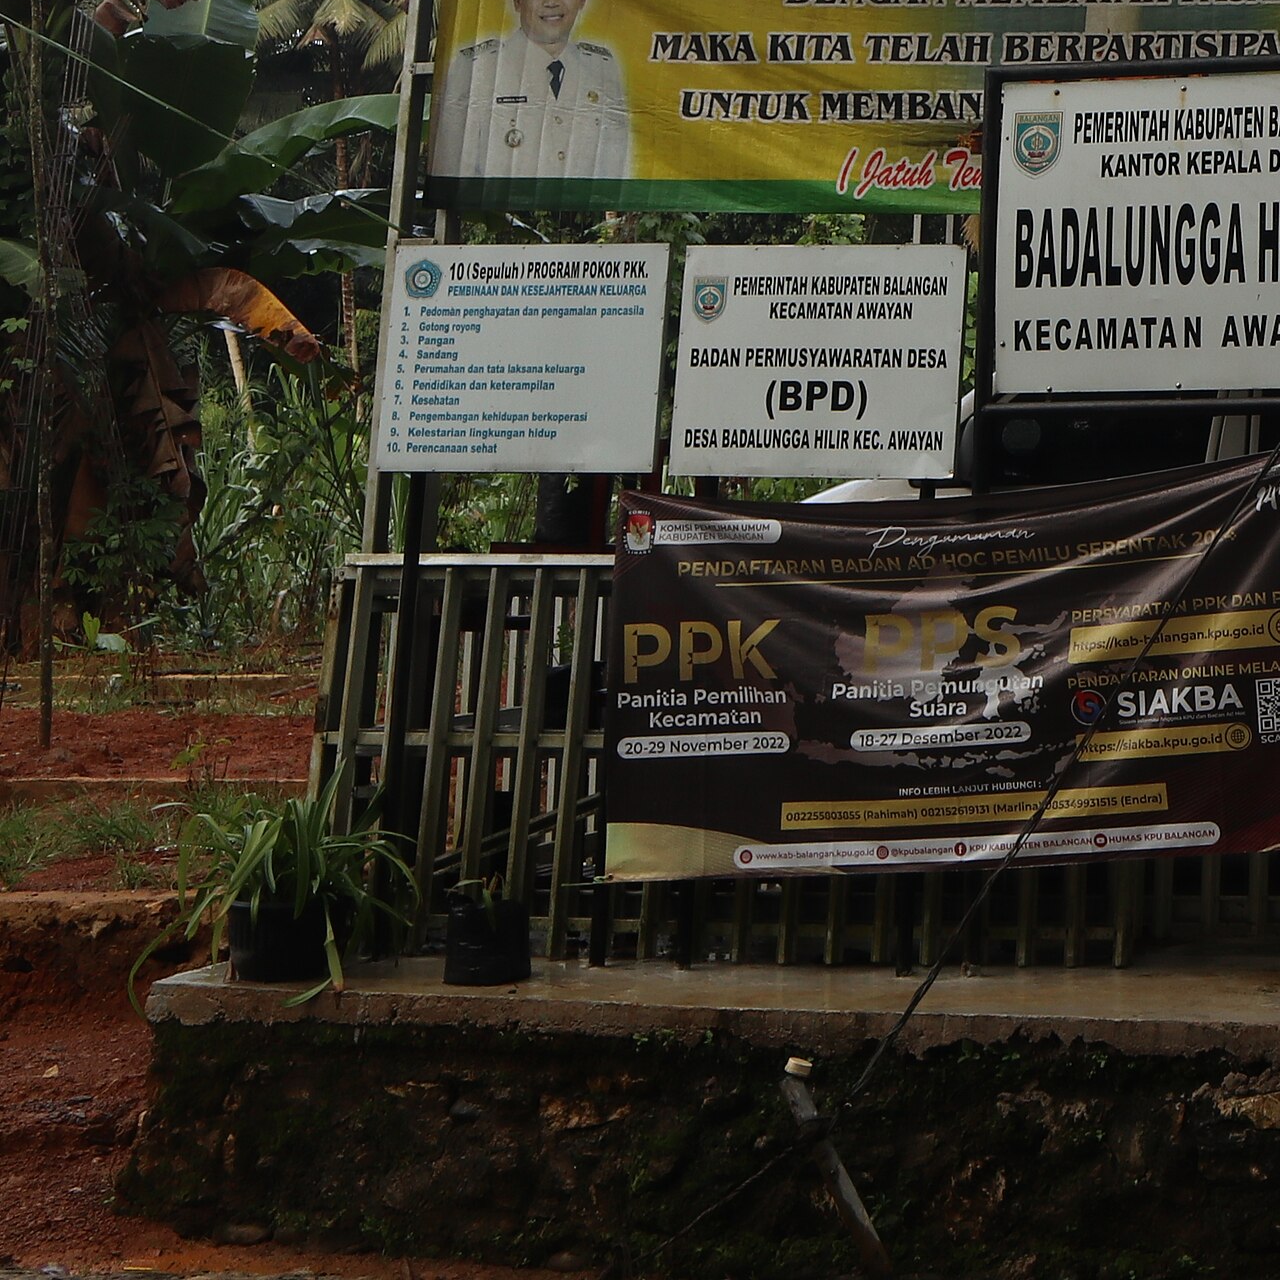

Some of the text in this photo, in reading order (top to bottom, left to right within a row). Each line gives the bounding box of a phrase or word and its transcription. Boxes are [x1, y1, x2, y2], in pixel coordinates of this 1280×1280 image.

[650, 34, 759, 62] MAKA
[768, 33, 852, 63] KITA
[866, 32, 991, 63] TELAH
[681, 90, 808, 121] UNTUK
[1073, 109, 1170, 144] PEMERINTAH
[1174, 106, 1264, 141] KABUPATEN
[1101, 153, 1180, 178] KANTOR
[1186, 150, 1262, 175] KEPALA
[1014, 202, 1246, 288] BADALUNGGA
[527, 261, 580, 279] PROGRAM
[582, 261, 620, 279] POKOK
[623, 261, 649, 279] PKK.
[448, 285, 647, 297] PEMBINAAN DAN KESEJAHTERAAN KELUARGA
[733, 276, 947, 296] PEMERINTAH KABUPATEN BALANGAN
[420, 305, 645, 319] Pedoman penghayatan pengamalan pancasila
[769, 302, 913, 320] KECAMATAN AWAYAN
[401, 322, 409, 332] 2.
[1014, 316, 1201, 352] KECAMATAN
[418, 336, 455, 347] Pangan
[416, 350, 458, 361] Sandang
[690, 348, 947, 369] BADAN PERMUSYAWARATAN DESA
[414, 364, 465, 374] Perumahan
[413, 380, 555, 392] Pendidikan keterampilan
[411, 395, 460, 405] Kesehatan
[765, 380, 868, 420] (BPD)
[409, 411, 588, 423] Pengembangan berkoperasi
[408, 427, 525, 439] Kelestarian lingkungan
[684, 429, 943, 451] DESA BADALUNGGA HILIR KEC. AWAYAN
[406, 443, 468, 453] Perencanaan
[678, 532, 1187, 577] PENDAFTARAN BADAN AD HOC PEMILU SERENTAK
[1071, 600, 1187, 623] PERSYARATAN
[1192, 596, 1228, 610] PPK
[1232, 592, 1267, 607] DAN
[864, 605, 1021, 674] PPS
[623, 619, 781, 684] PPK
[1182, 663, 1235, 679] ONLINE
[832, 674, 1044, 700] Panitia Pemungutan
[617, 686, 787, 709] Panitia Pemilihan
[1117, 683, 1244, 719] SIAKBA
[649, 709, 762, 729] Kecamatan
[909, 700, 967, 718] Suara
[625, 736, 785, 755] 20-29 November 2022
[859, 726, 1022, 747] 18-27 Desember 2022
[899, 784, 989, 797] INFO LANJUT
[863, 808, 918, 822] (Rahimah)
[1120, 793, 1162, 807] (Endra)
[1108, 833, 1142, 844] HUMAS
